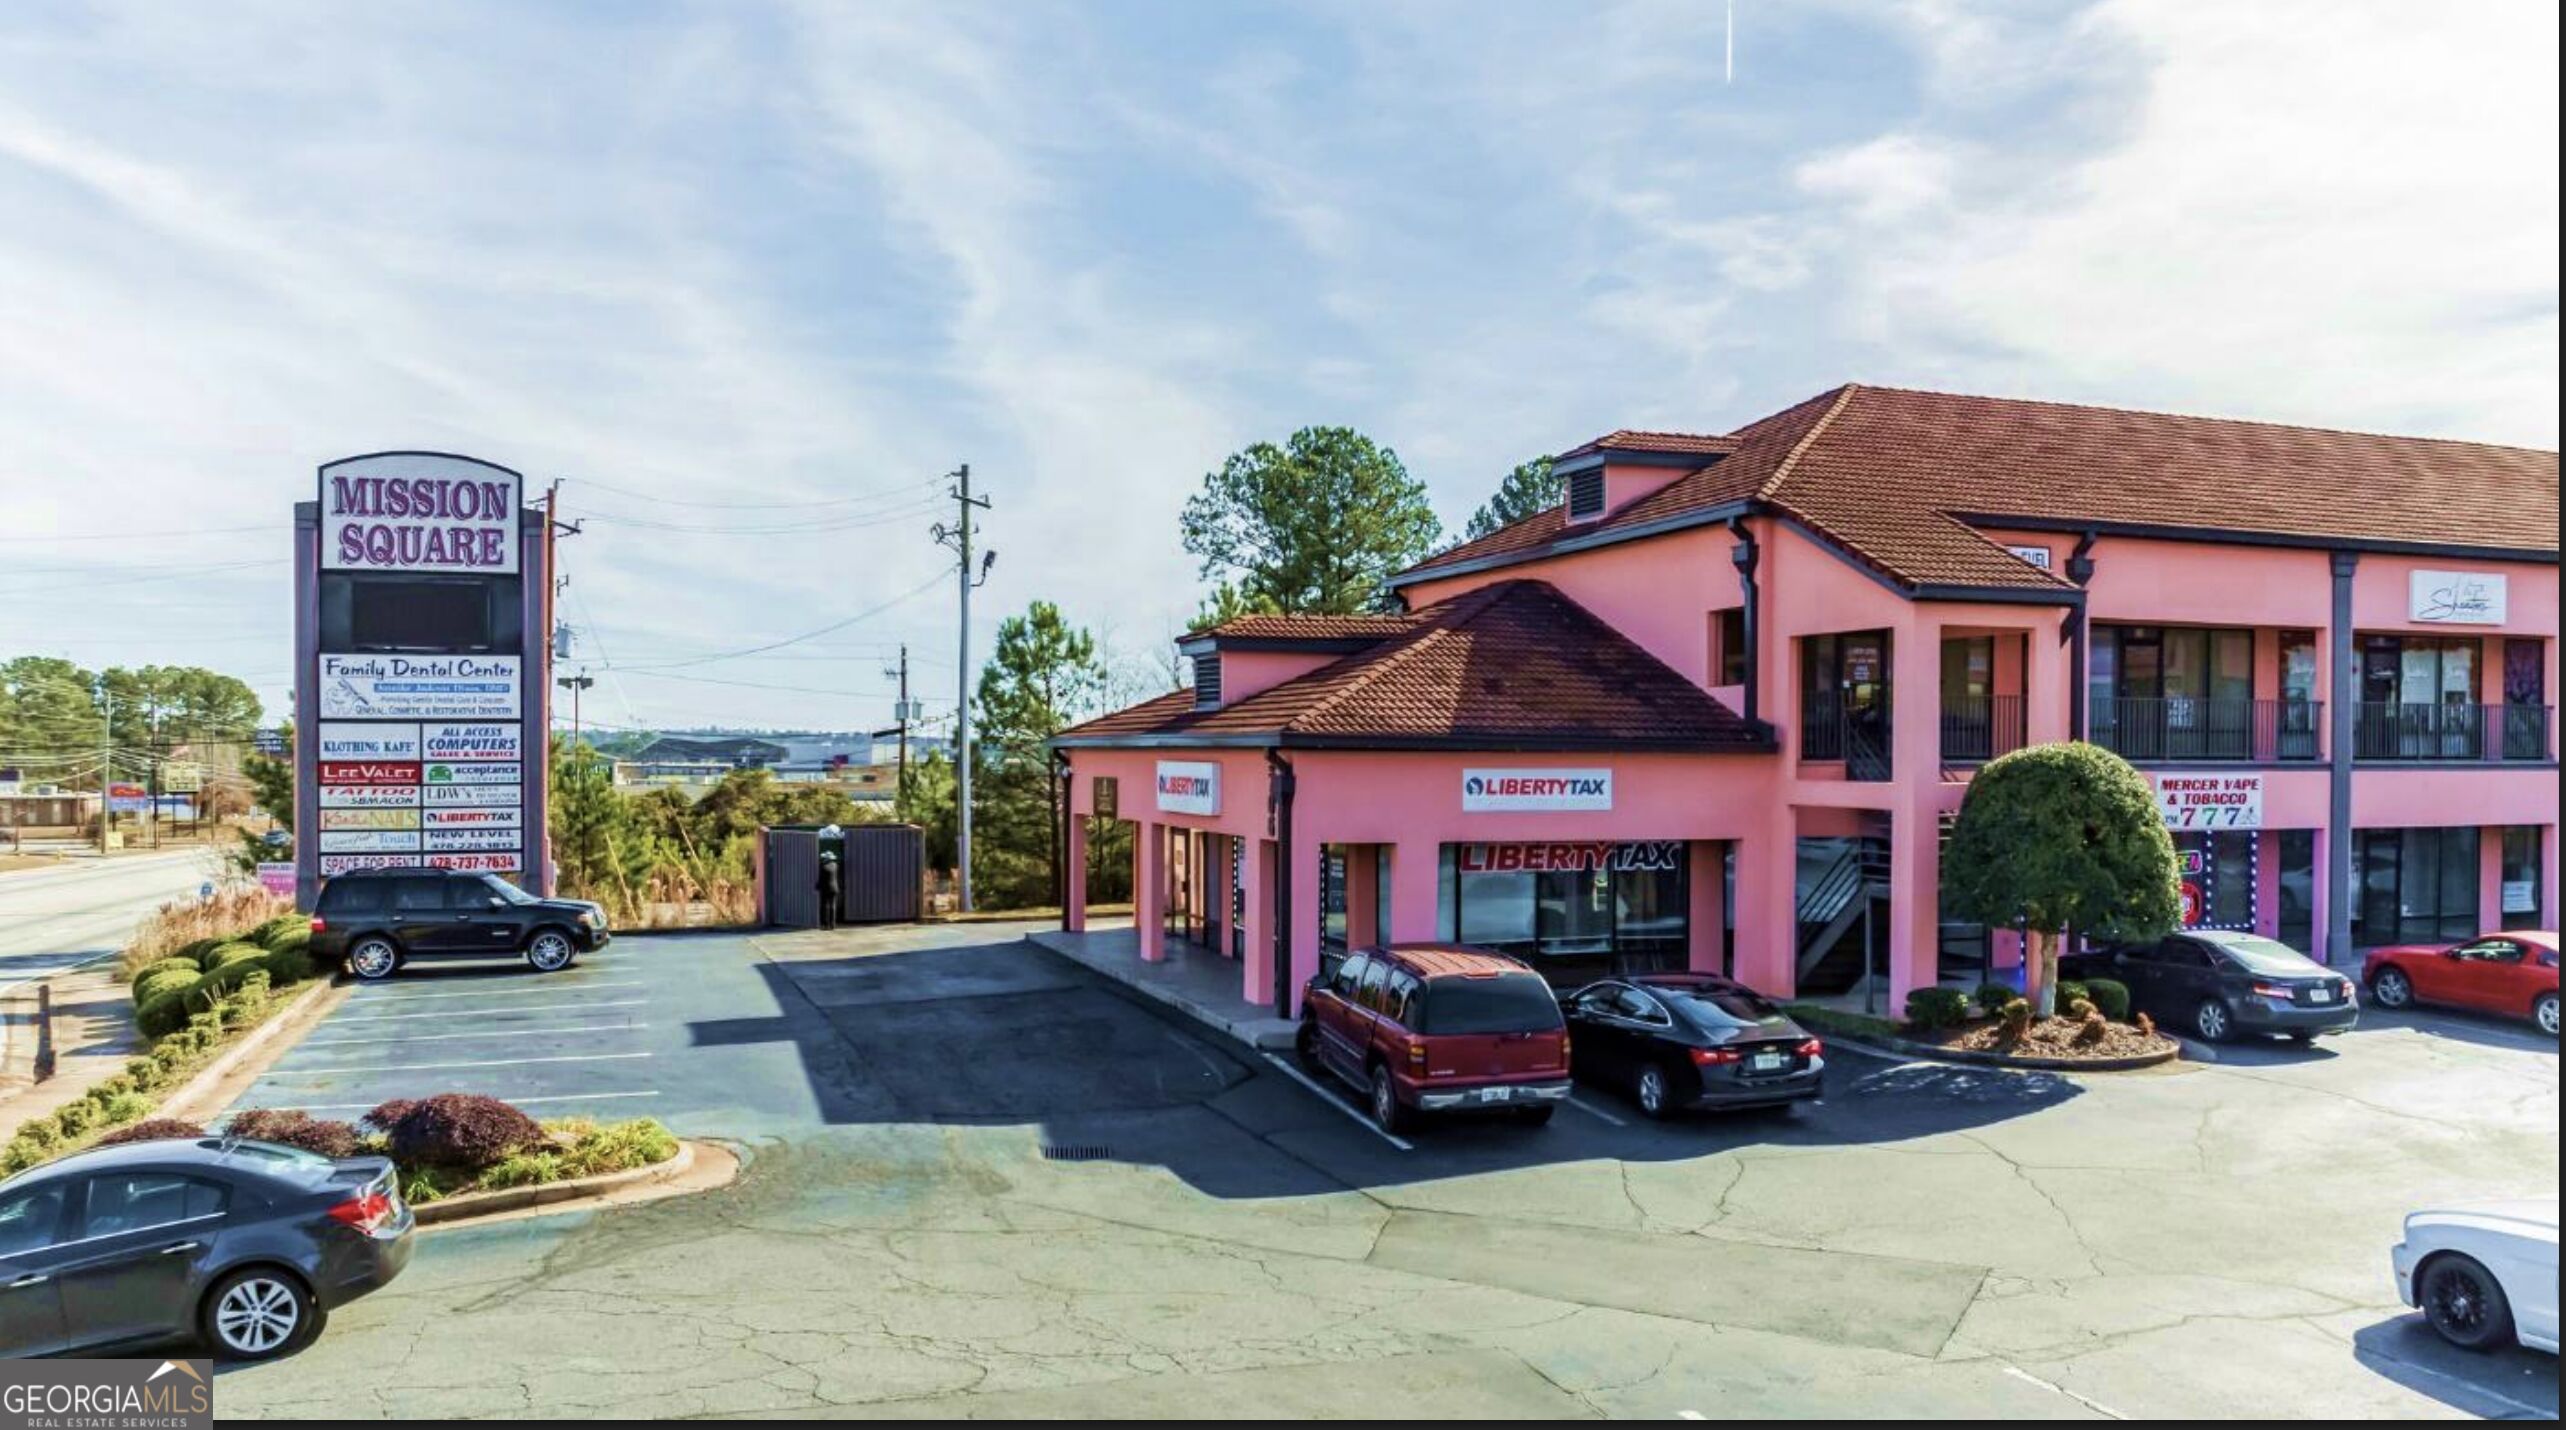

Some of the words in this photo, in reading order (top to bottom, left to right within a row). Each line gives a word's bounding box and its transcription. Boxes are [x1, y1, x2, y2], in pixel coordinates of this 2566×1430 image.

[331, 476, 510, 520] MISSION
[338, 523, 504, 567] SQUARE
[326, 658, 385, 680] Family
[391, 659, 453, 677] Dental
[457, 659, 513, 677] Center
[442, 727, 459, 736] ALL
[464, 727, 502, 736] ACCESS
[427, 738, 516, 750] COMPUTERS
[1485, 779, 1605, 796] LIBERTYTAX
[2161, 779, 2219, 790] MERCER
[2224, 779, 2259, 790] VAPE
[2167, 793, 2177, 805] &
[2185, 793, 2247, 805] TOBACCO
[1460, 841, 1682, 872] LIBERTYTAX
